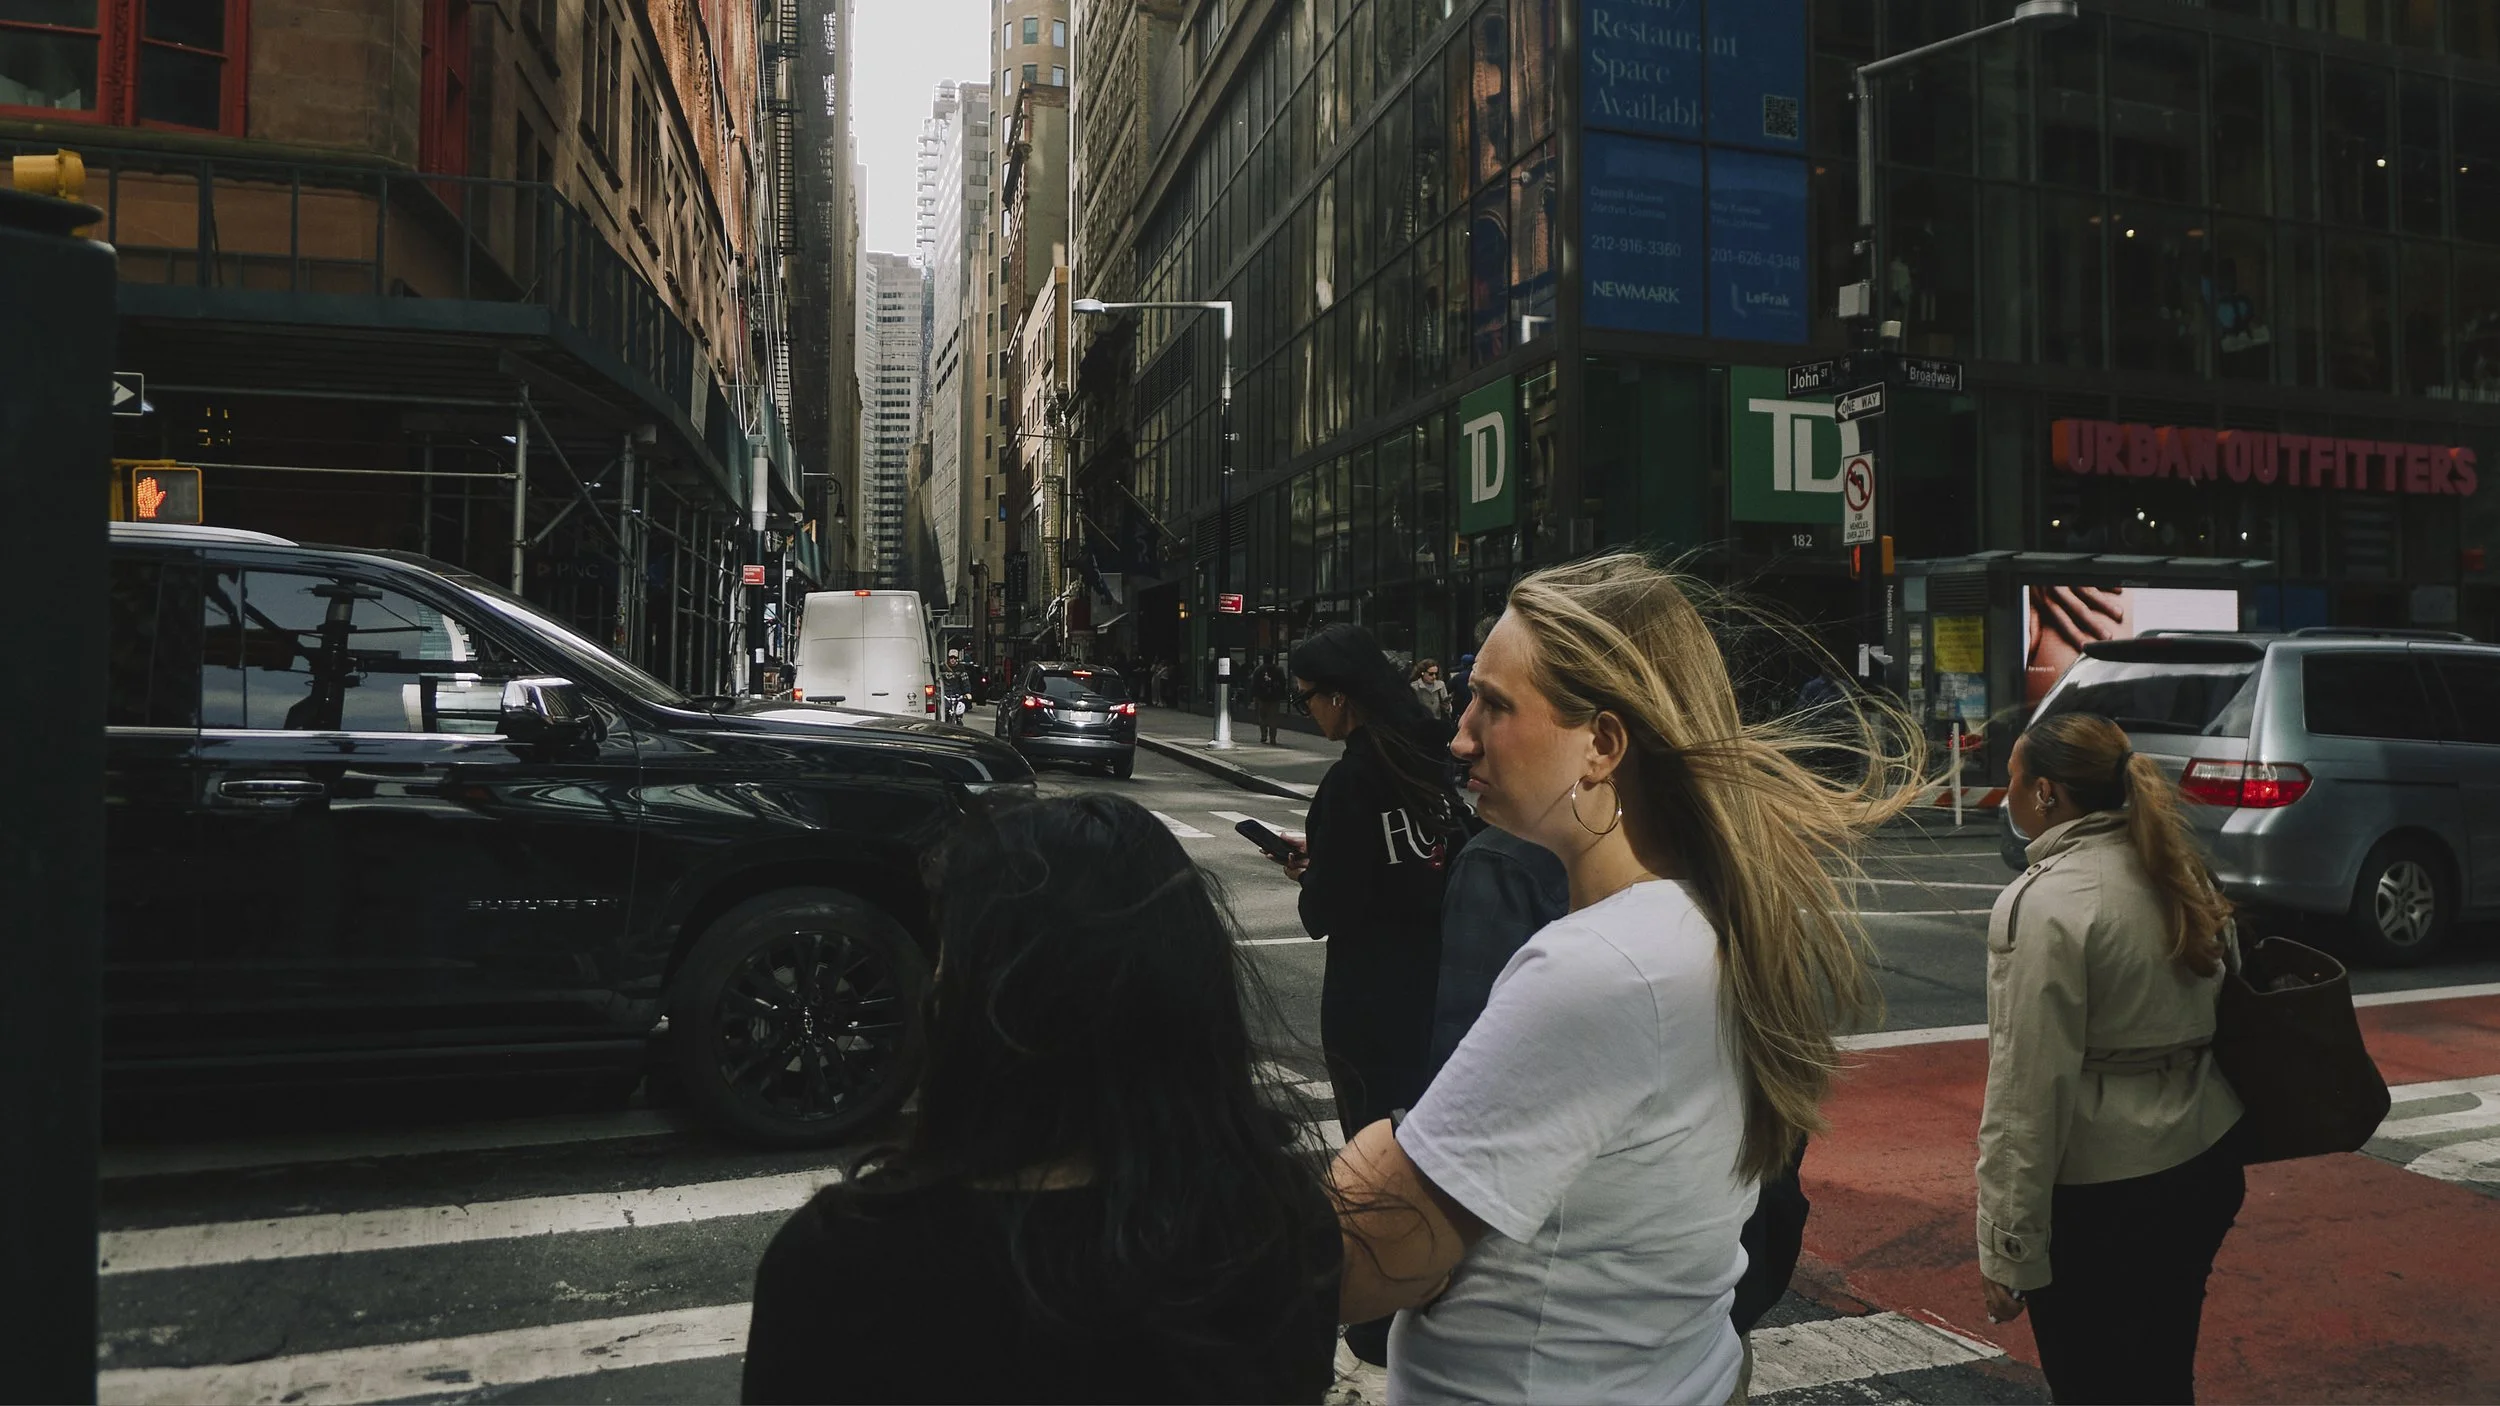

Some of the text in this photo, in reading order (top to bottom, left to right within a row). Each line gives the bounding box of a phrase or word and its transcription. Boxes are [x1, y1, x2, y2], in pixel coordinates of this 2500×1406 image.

[1591, 48, 1670, 87] Space
[1591, 279, 1681, 305] NEWMARK
[1745, 291, 1791, 308] LeFrak
[1792, 372, 1820, 389] John
[1909, 365, 1957, 386] Broadway
[1841, 393, 1880, 414] ONE WAY
[1463, 410, 1506, 504] TD
[1749, 398, 1860, 493] TD
[2052, 419, 2480, 496] URBAN OUTFITTERS
[1792, 534, 1812, 547] 182
